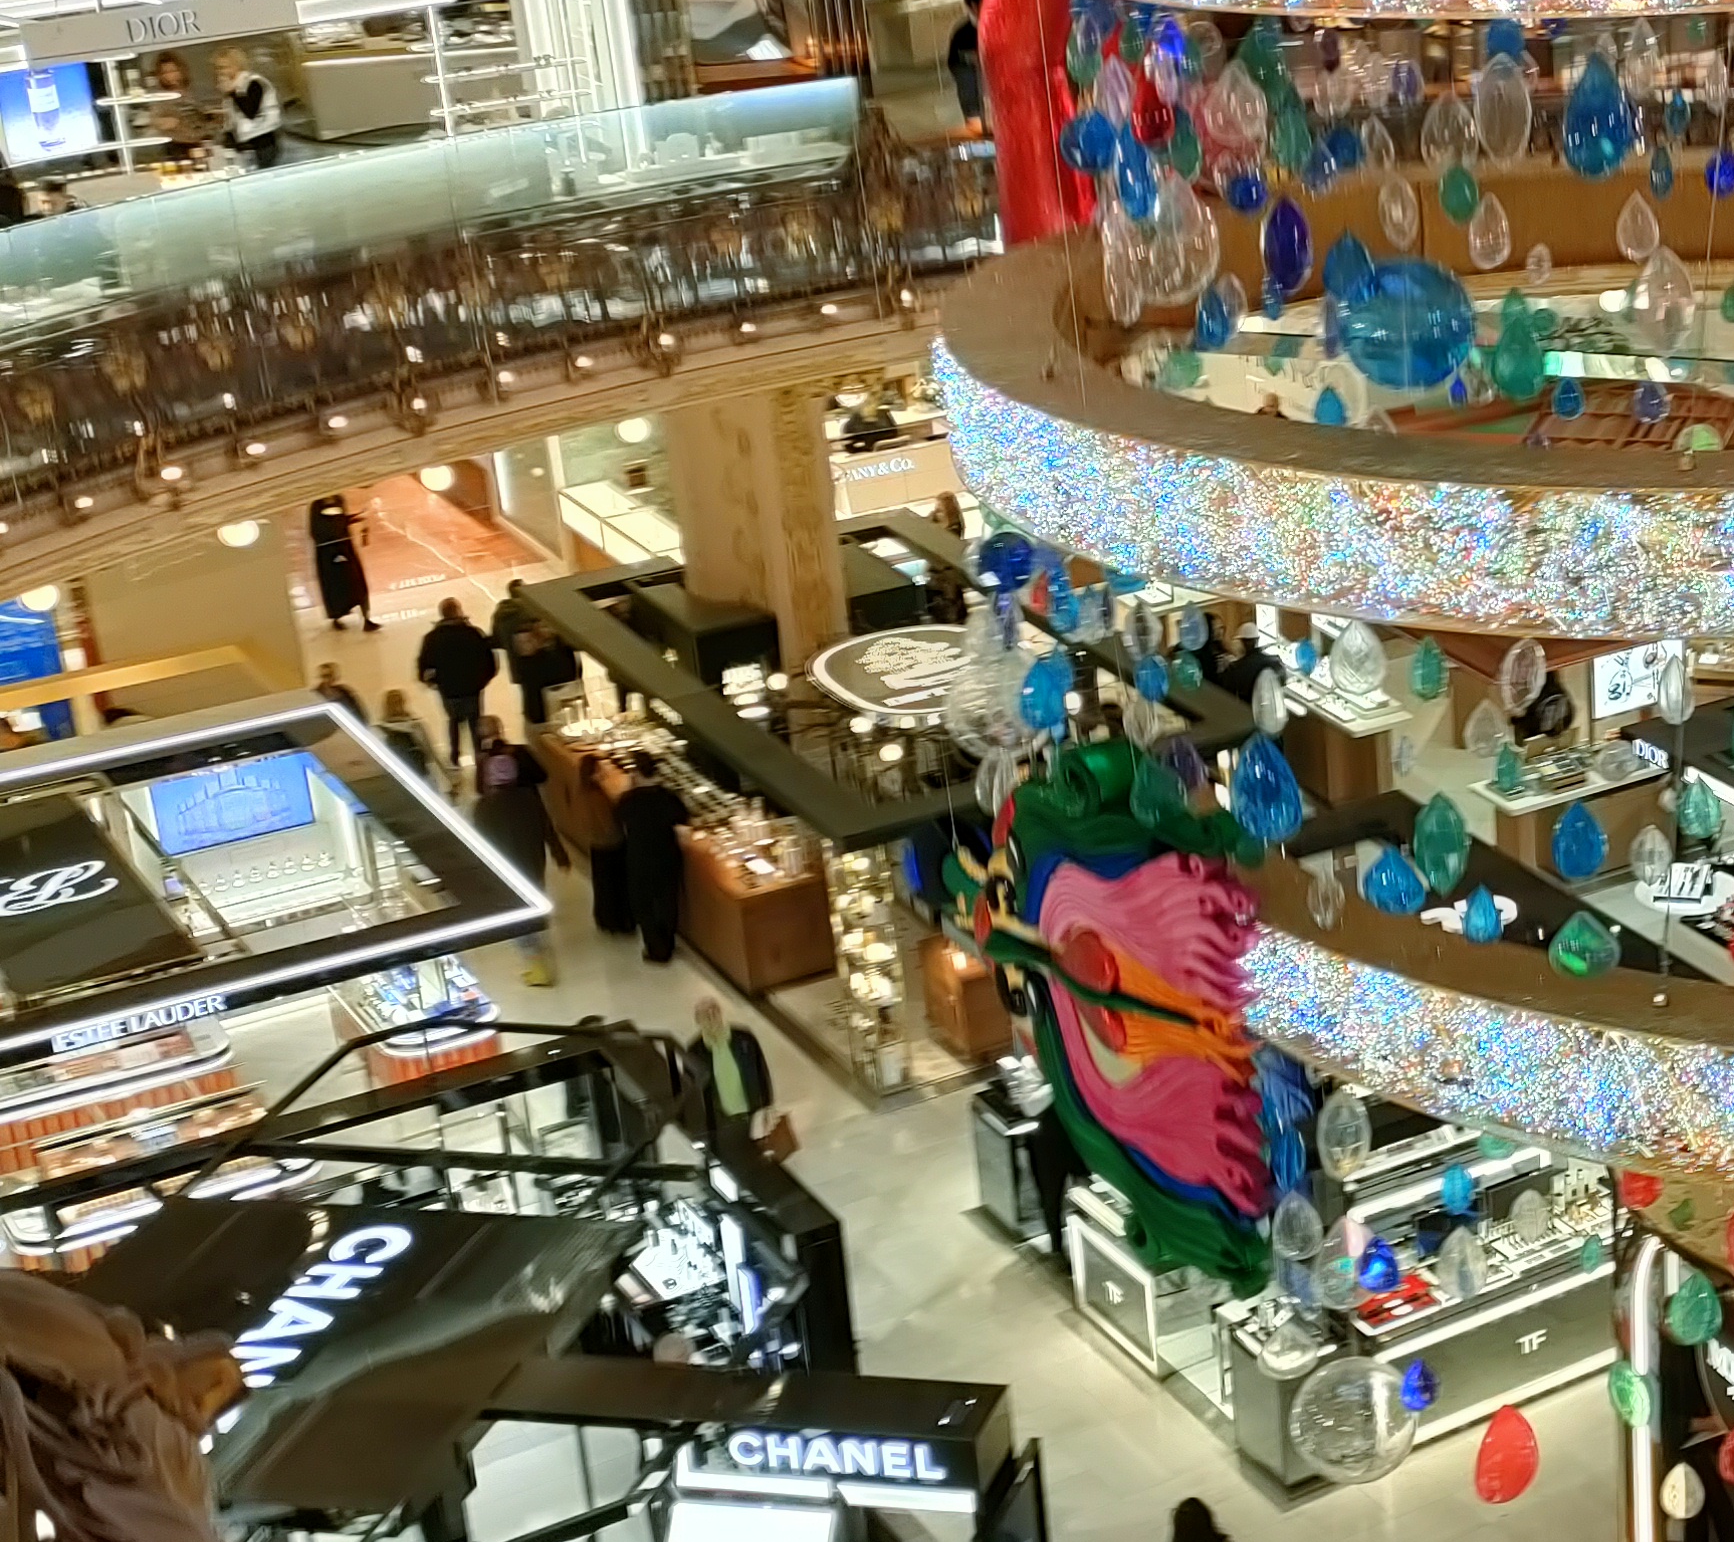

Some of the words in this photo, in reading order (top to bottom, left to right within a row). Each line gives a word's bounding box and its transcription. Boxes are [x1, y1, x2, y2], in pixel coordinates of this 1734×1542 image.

[125, 8, 201, 43] DIOR
[1632, 737, 1670, 770] DIOR
[128, 993, 228, 1036] LAUDER
[200, 1223, 413, 1455] CHAN
[1514, 1327, 1548, 1355] TF
[727, 1431, 947, 1481] CHANEL
